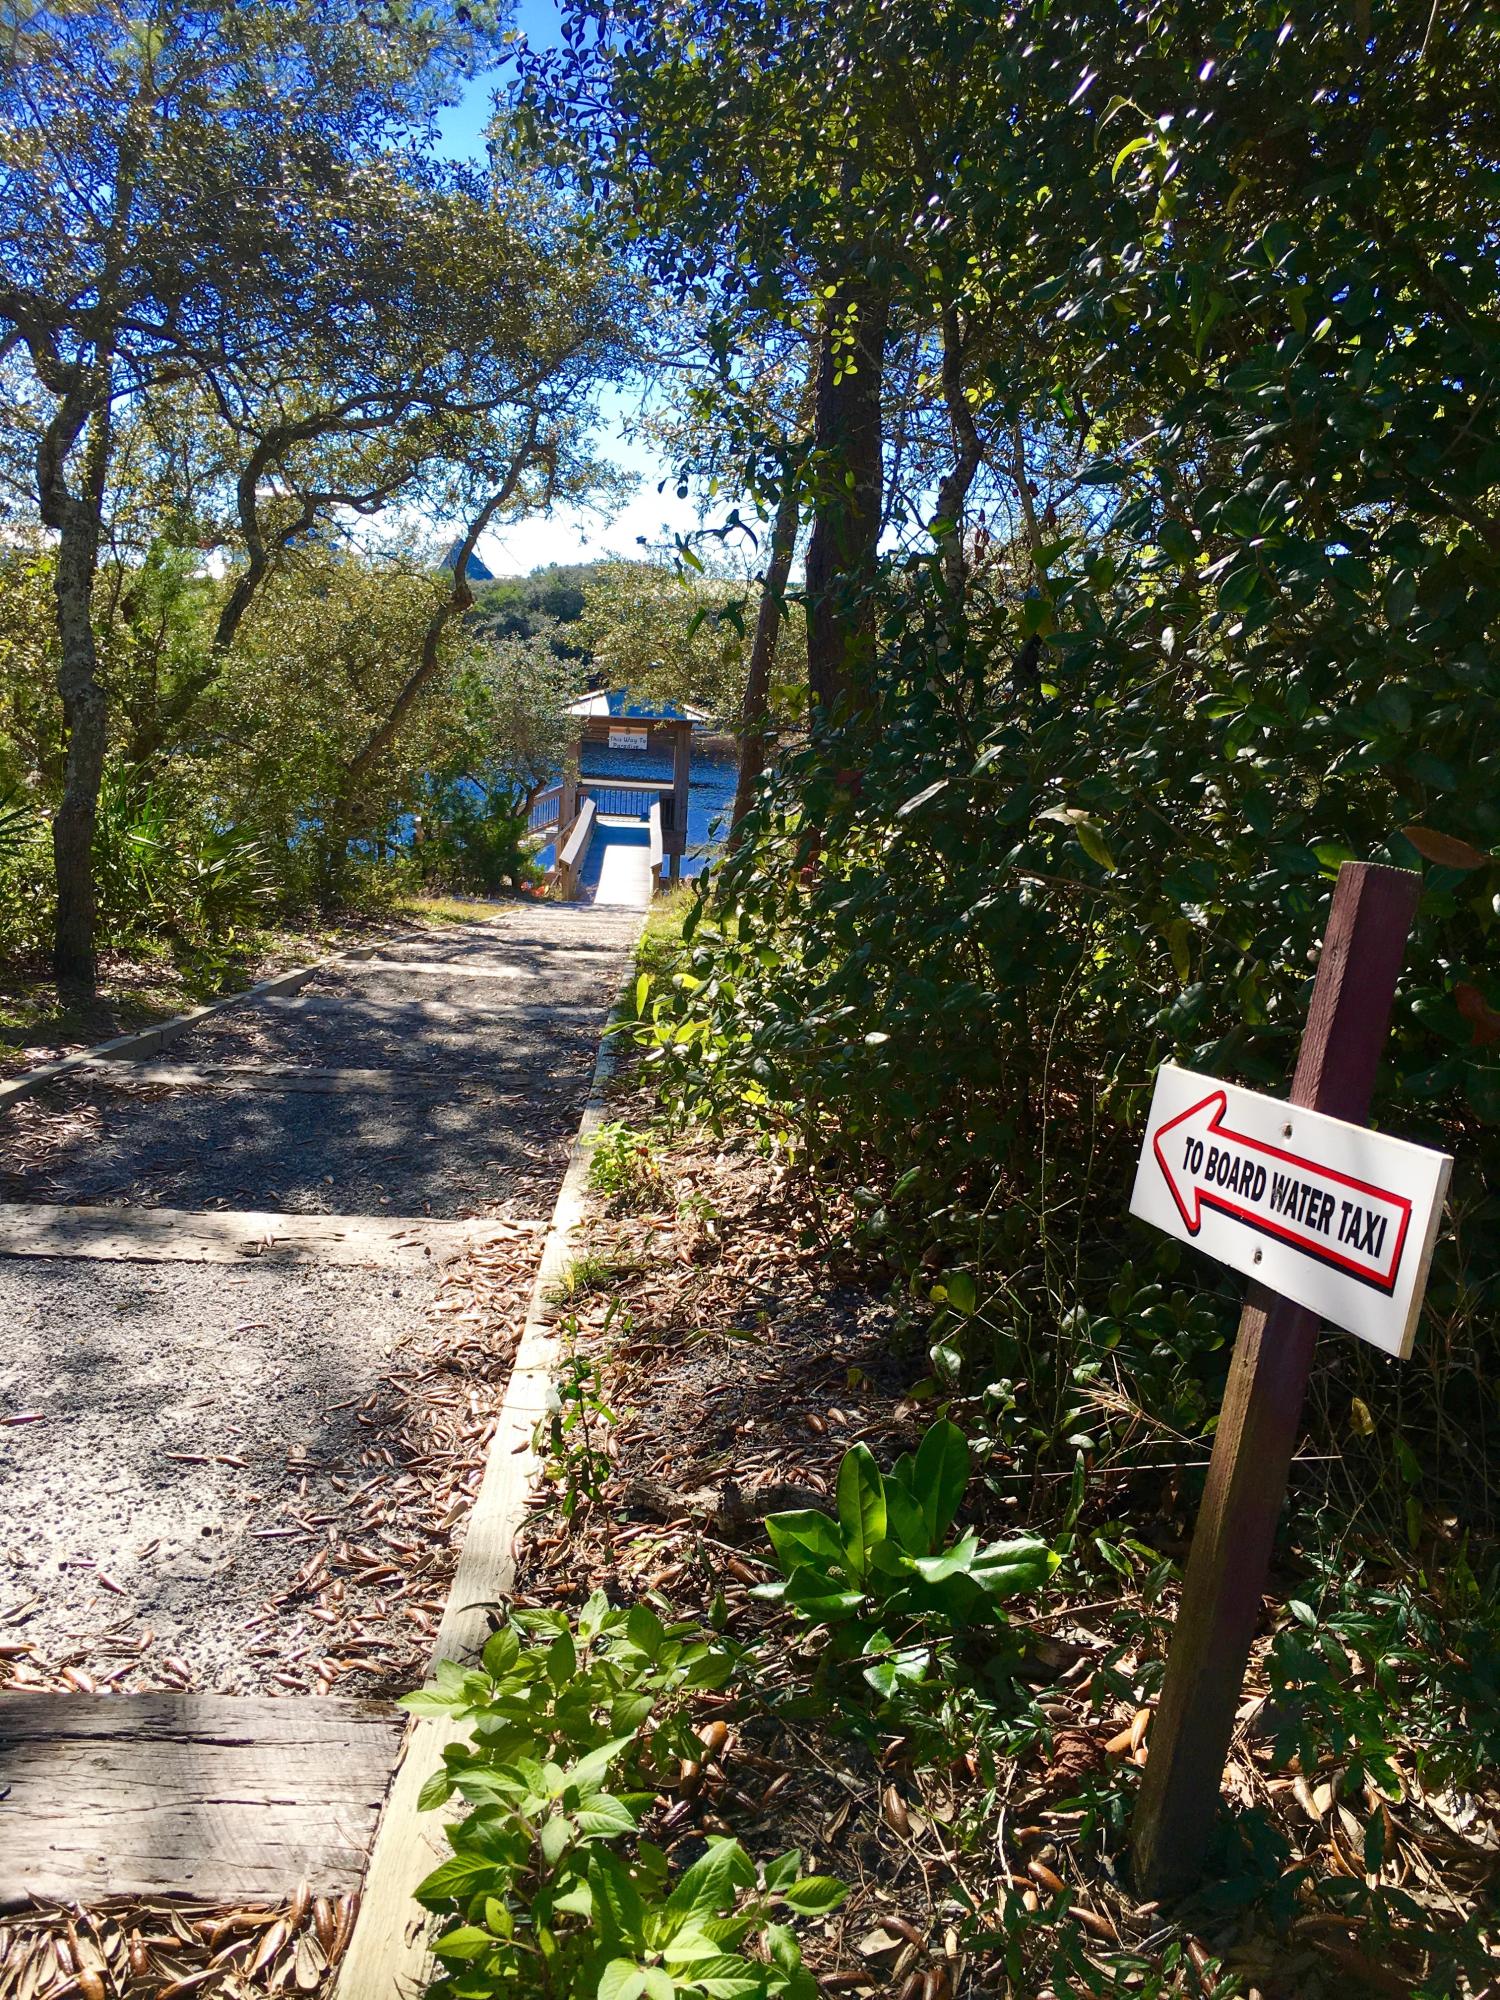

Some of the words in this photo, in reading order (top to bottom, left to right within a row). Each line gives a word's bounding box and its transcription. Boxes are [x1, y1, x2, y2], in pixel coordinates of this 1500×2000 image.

[624, 736, 637, 744] Way
[1183, 1137, 1203, 1174] TO
[1204, 1146, 1267, 1202] BOARD
[1269, 1171, 1336, 1235] WATER
[1337, 1200, 1388, 1258] TAXI
